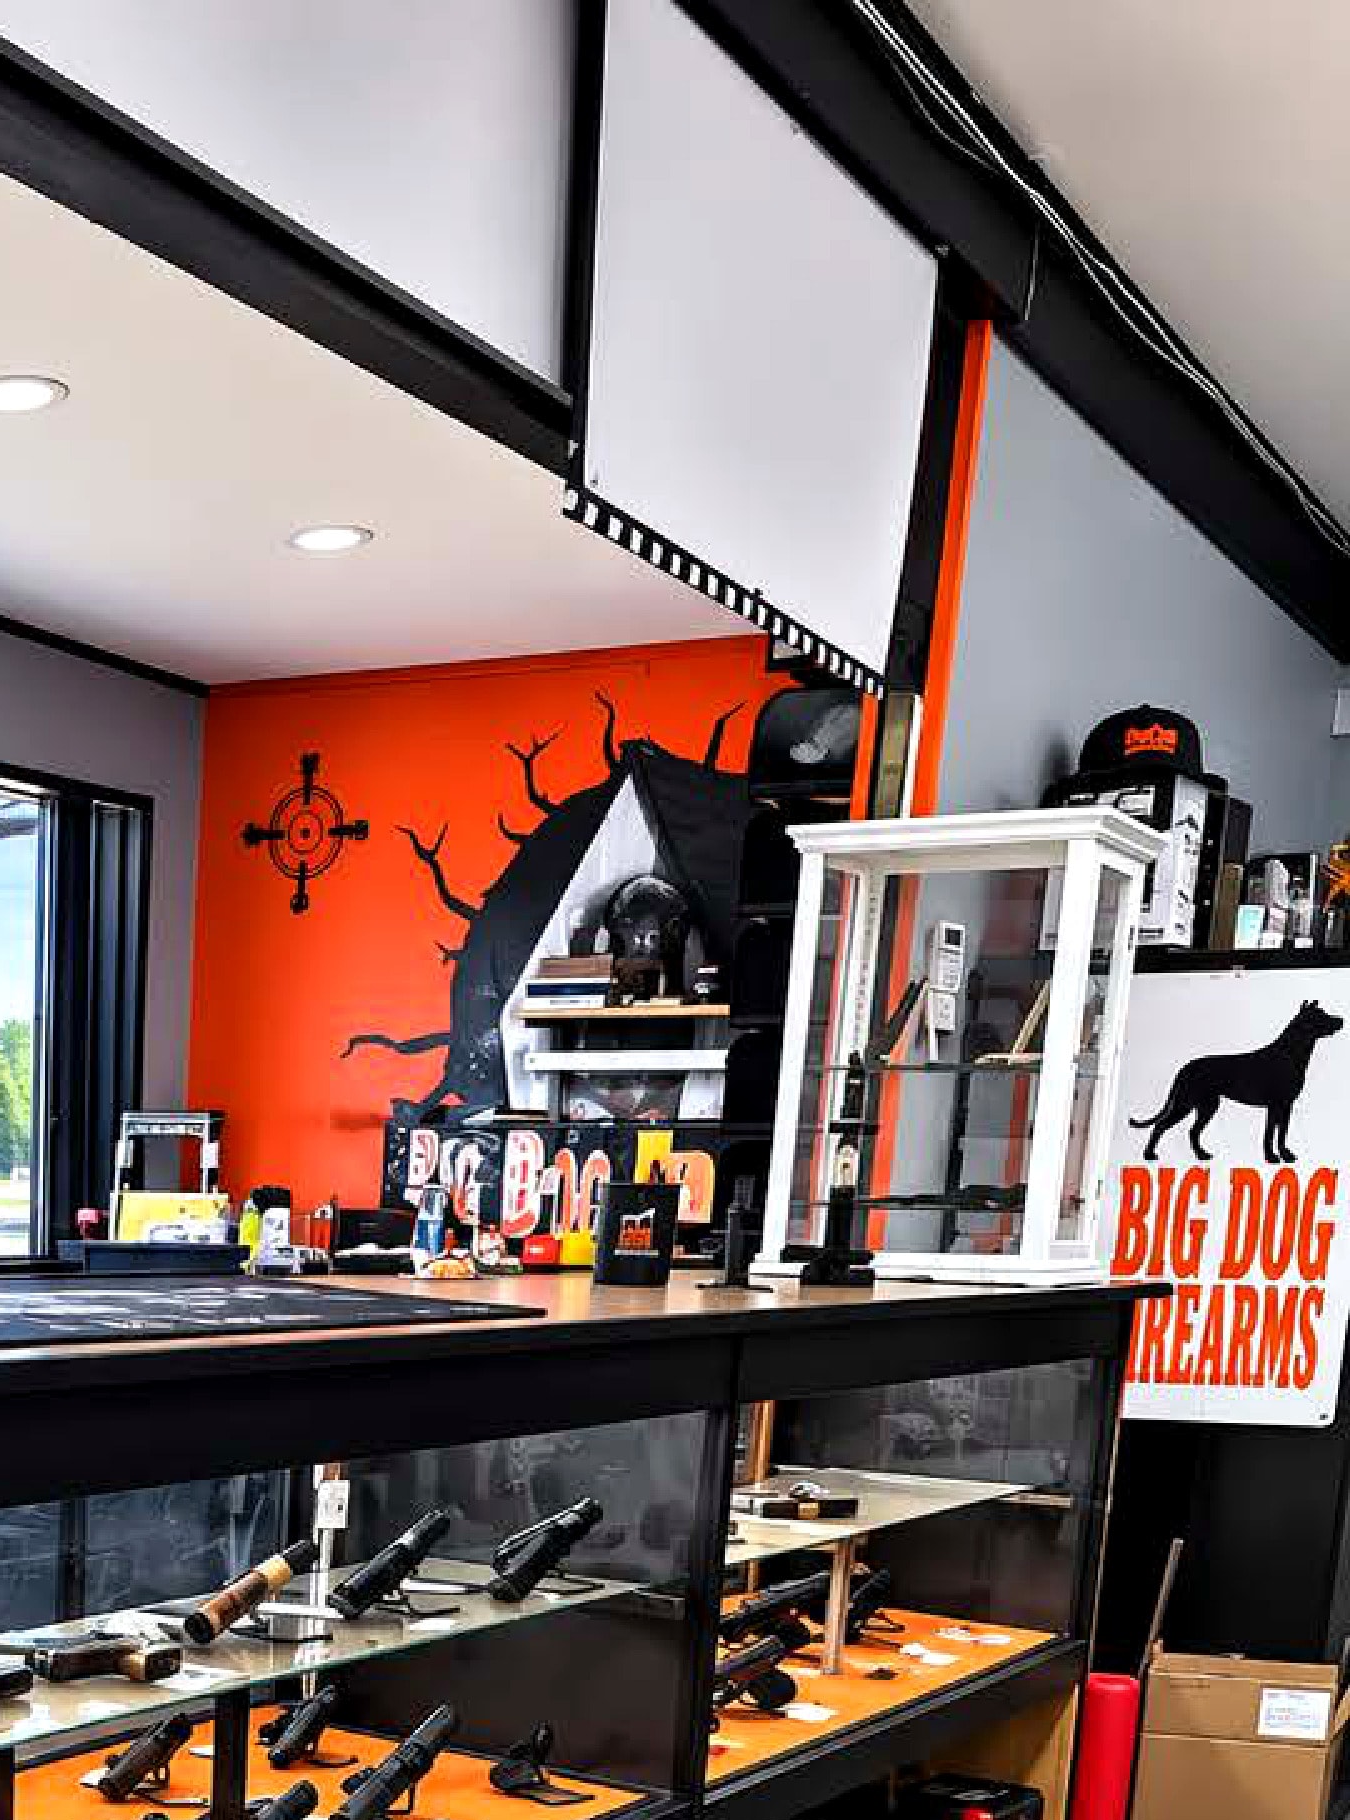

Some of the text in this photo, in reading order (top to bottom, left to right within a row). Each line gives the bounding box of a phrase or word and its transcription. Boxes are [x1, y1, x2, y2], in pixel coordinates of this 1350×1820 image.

[1110, 1165, 1338, 1281] BIG DOG
[1124, 1284, 1326, 1391] IREARMS
